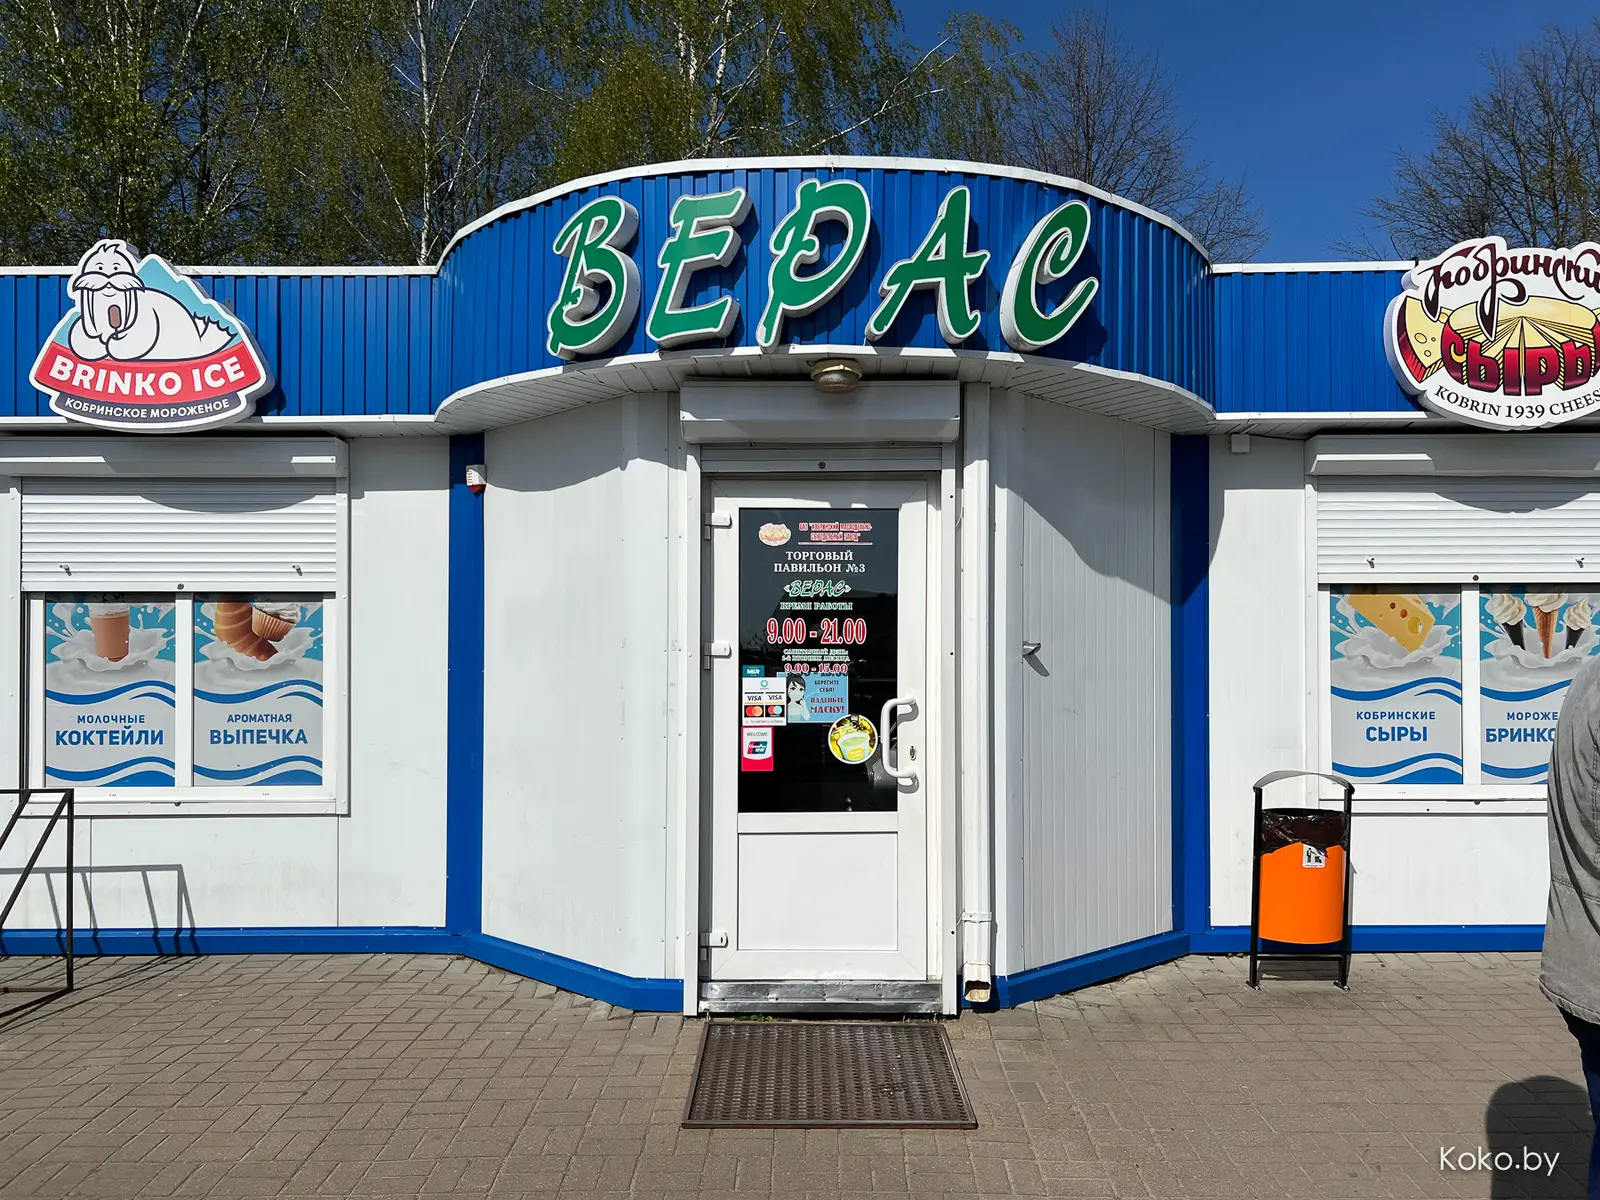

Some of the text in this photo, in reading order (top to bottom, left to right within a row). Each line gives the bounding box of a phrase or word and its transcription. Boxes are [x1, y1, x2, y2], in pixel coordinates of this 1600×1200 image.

[546, 177, 1100, 359] ВЕРАС
[48, 354, 246, 396] BRINKO ICE
[65, 397, 230, 418] КОБРИНСКОЕ МОРОЖЕНОЕ
[1434, 385, 1502, 418] KOBRIN
[1505, 404, 1546, 419] 1939
[785, 550, 854, 561] ТОРГОВЫЙ
[773, 563, 866, 573] ПАВИЛЬОН №3
[779, 602, 853, 610] ВРЕМЯ РАБОТЫ
[767, 617, 807, 644] 9.00
[820, 617, 867, 644] 21.00
[784, 663, 809, 673] 9.00
[818, 663, 848, 673] 15.00
[810, 705, 845, 713] МАСКУ!
[77, 714, 145, 724] МОЛОЧНЫЕ
[226, 713, 293, 723] АРОМАТНАЯ
[1356, 711, 1436, 720] КОБРИНСКИЕ
[1507, 711, 1559, 721] МОРОЖЕ
[55, 725, 164, 745] КОКТЕЙЛИ
[209, 728, 308, 745] ВЫПЕЧКА
[1365, 726, 1428, 742] СЫРЫ
